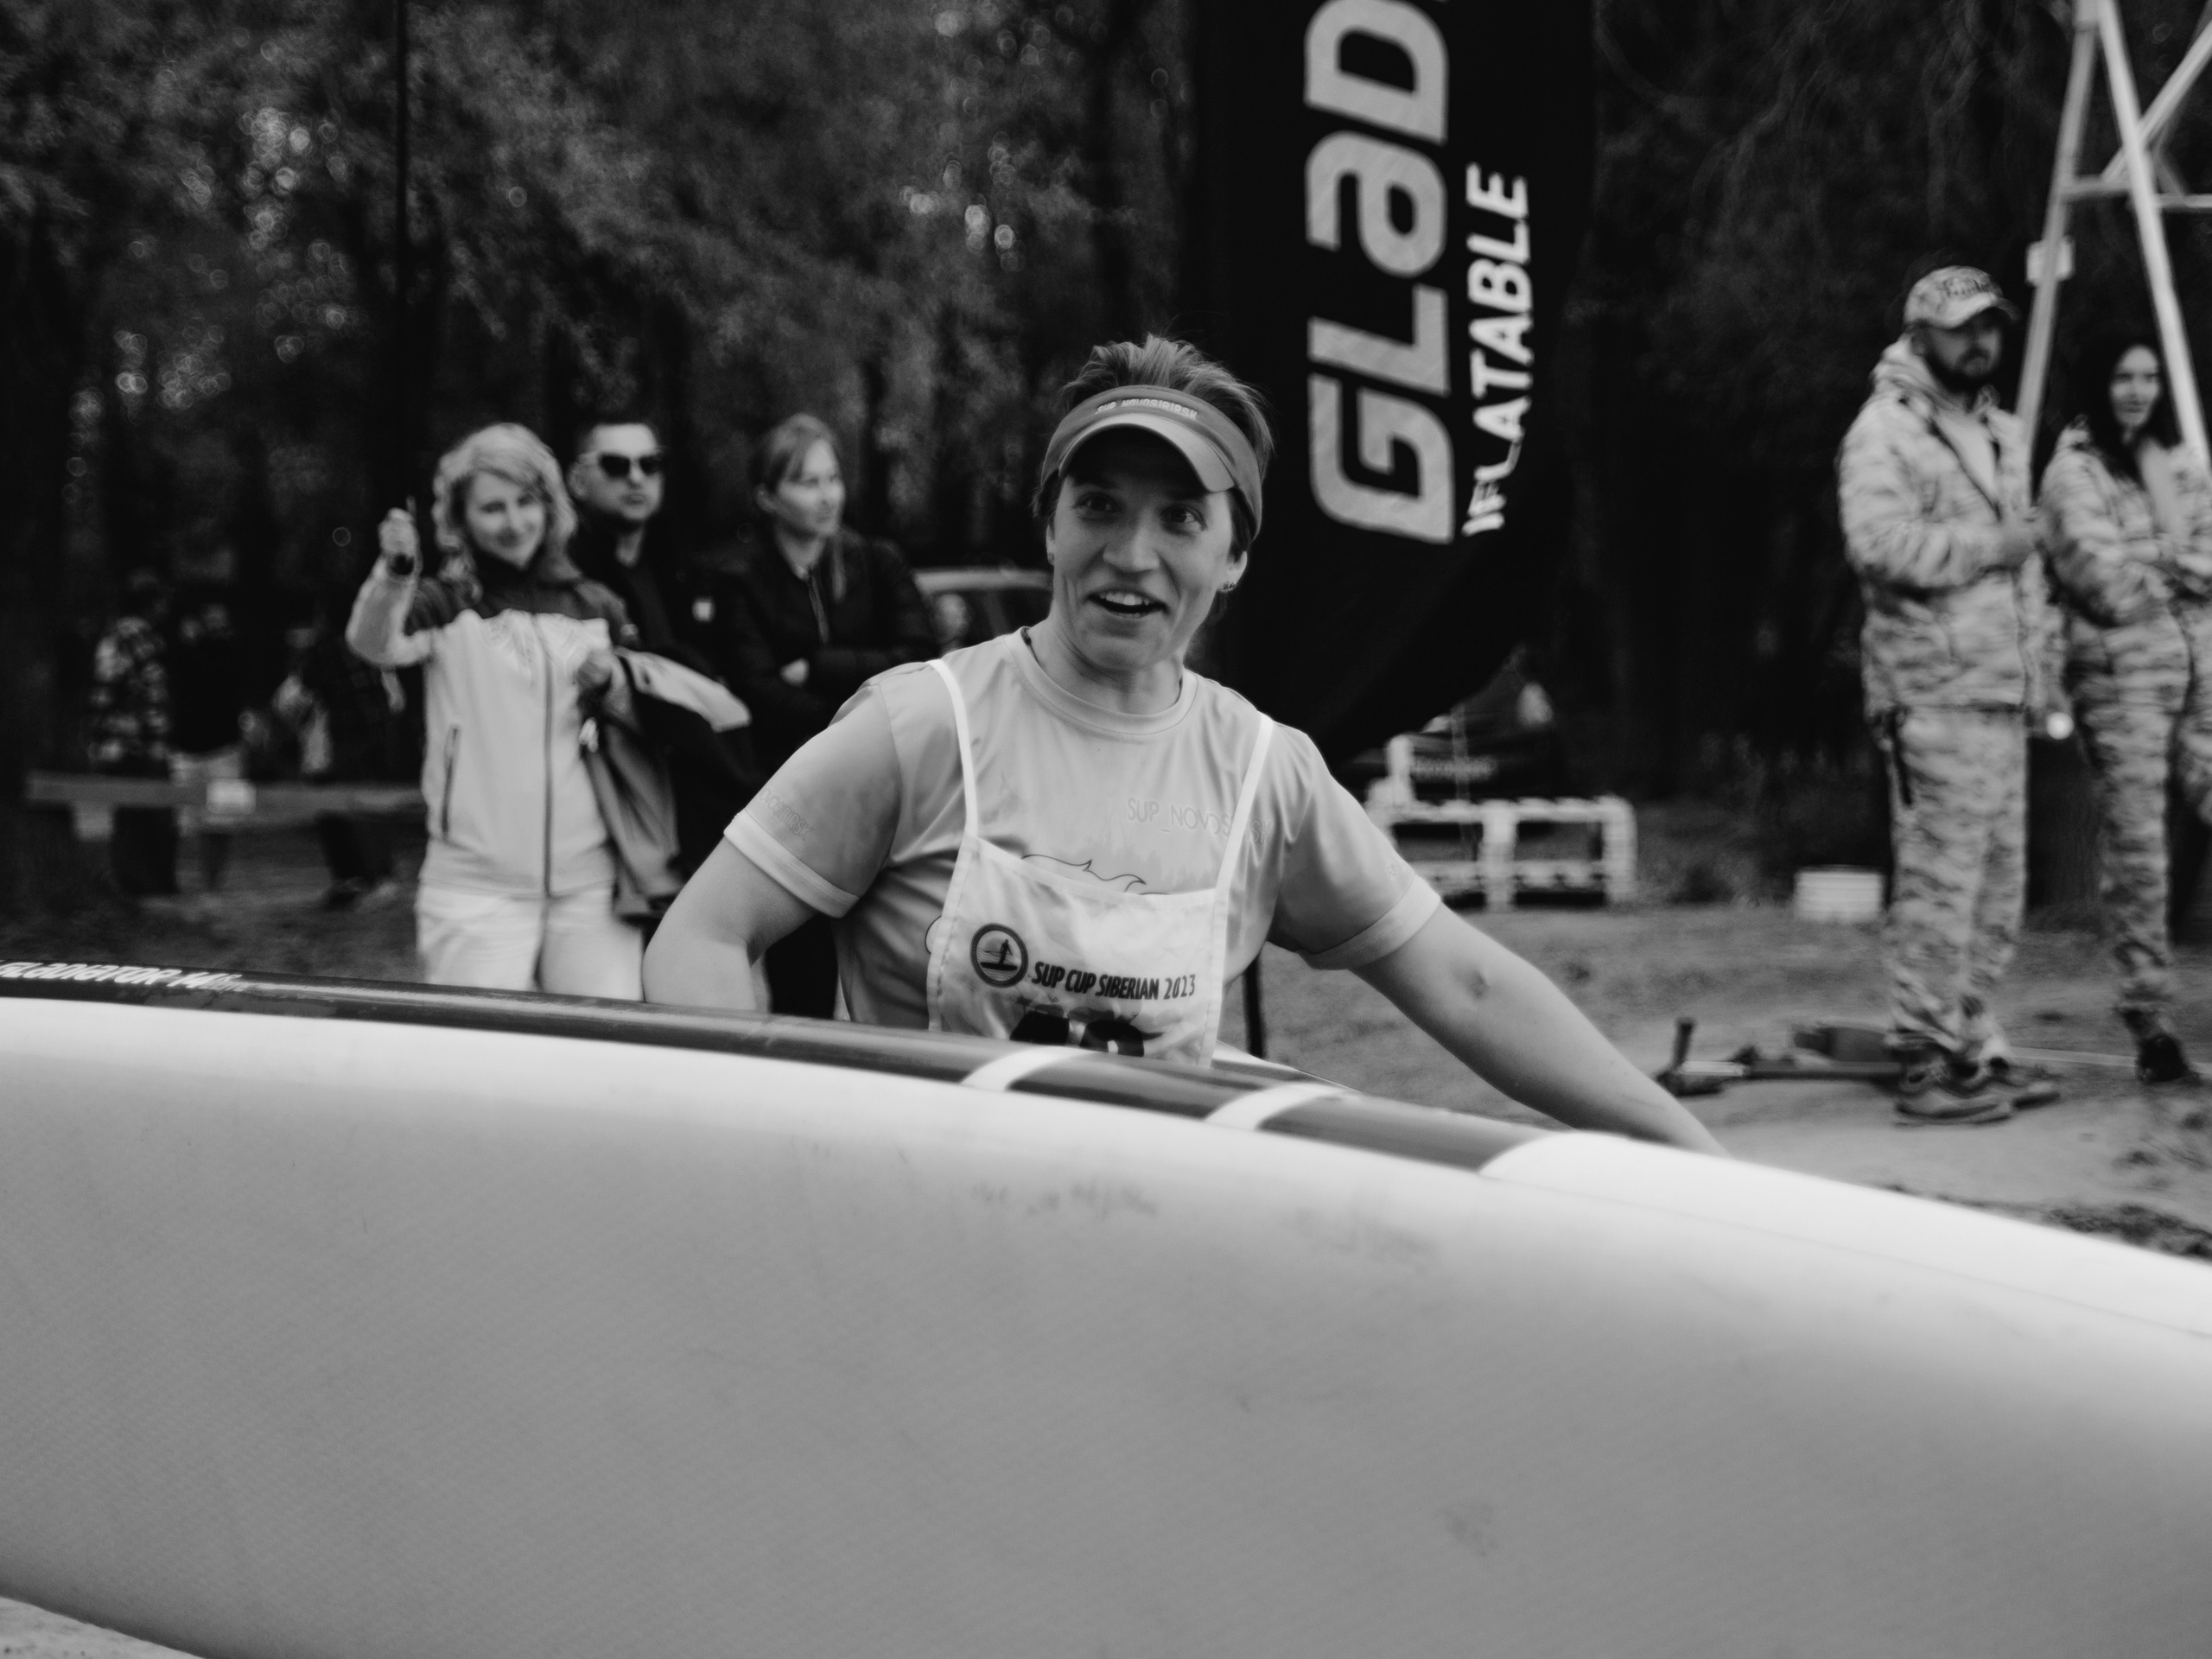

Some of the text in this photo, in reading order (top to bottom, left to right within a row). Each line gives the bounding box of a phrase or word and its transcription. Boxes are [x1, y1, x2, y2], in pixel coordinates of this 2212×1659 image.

[1303, 0, 1456, 545] GLaD
[1031, 961, 1197, 1000] SUP CUP SIBERIAN 2023
